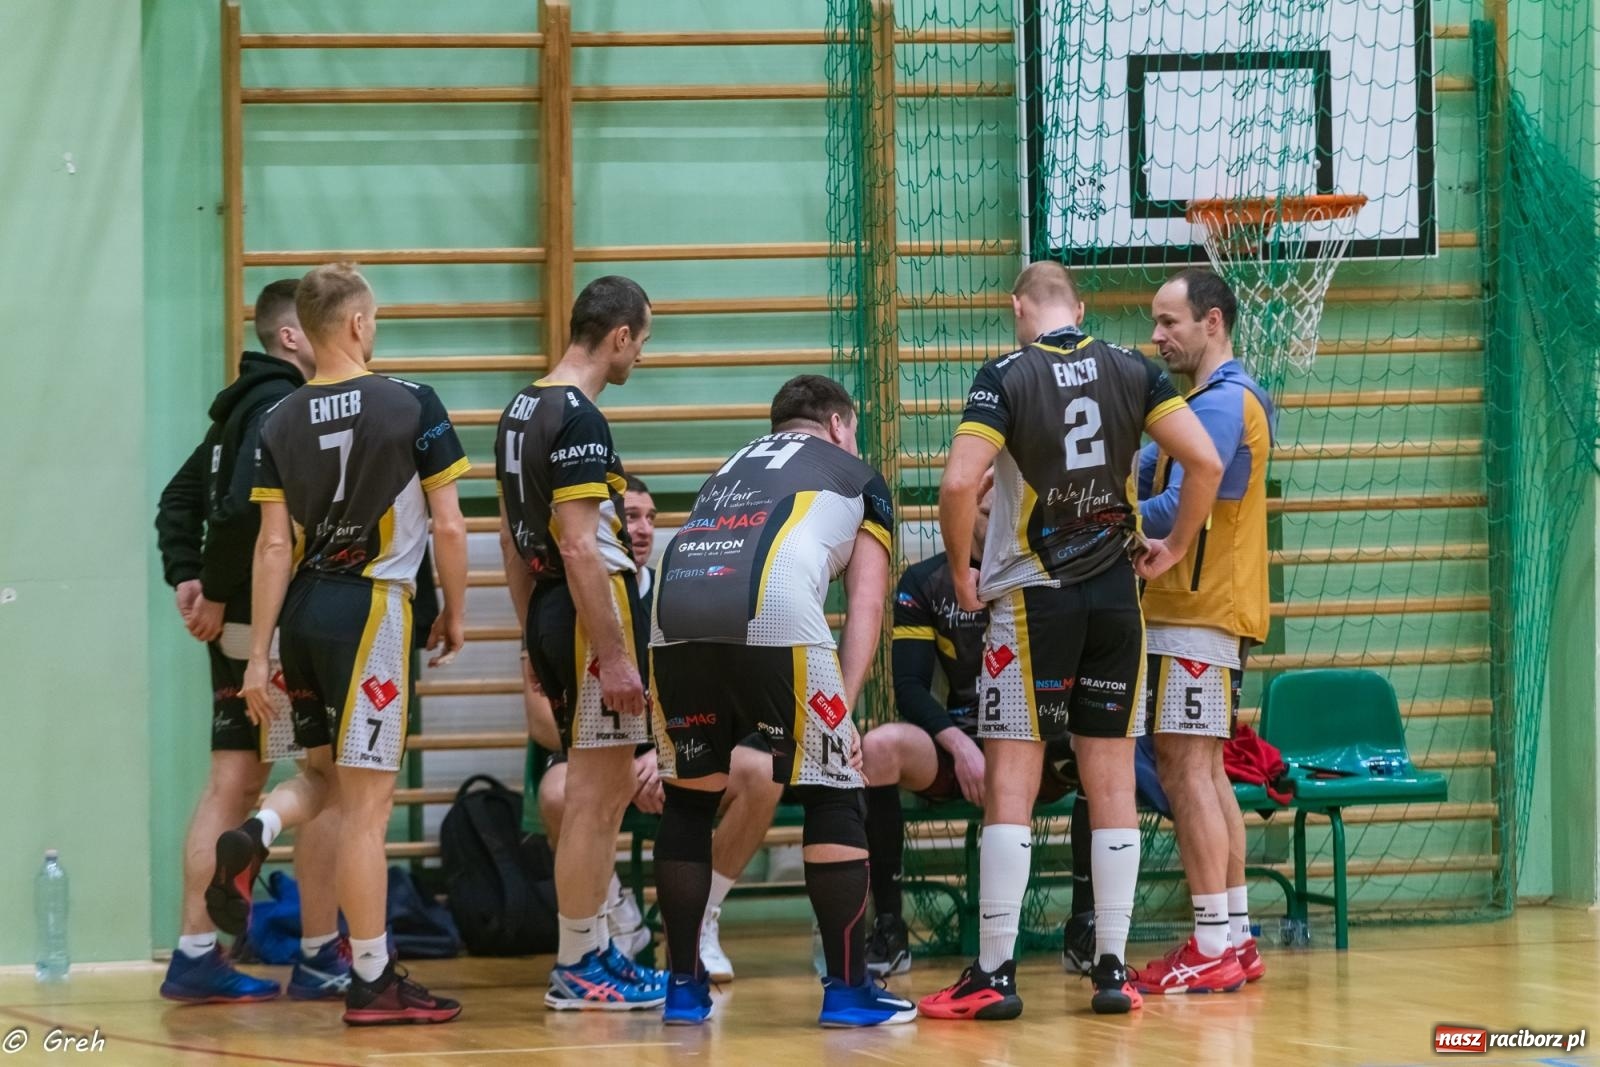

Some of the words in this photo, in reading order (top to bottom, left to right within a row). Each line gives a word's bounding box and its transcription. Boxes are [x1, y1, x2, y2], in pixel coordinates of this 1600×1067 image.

[1053, 357, 1098, 387] ENTER
[309, 389, 361, 425] ENTER
[1064, 396, 1106, 471] 2
[318, 428, 354, 503] 7
[505, 430, 525, 503] 4
[716, 441, 805, 477] 14
[714, 480, 761, 511] Hair
[1074, 479, 1112, 518] Hair
[678, 539, 745, 552] GRAVTON
[1080, 677, 1126, 690] GRAVTON
[600, 698, 620, 730] 4
[816, 695, 838, 720] Enter
[985, 687, 1001, 720] 2
[1185, 687, 1203, 719] 5
[367, 717, 383, 751] 7
